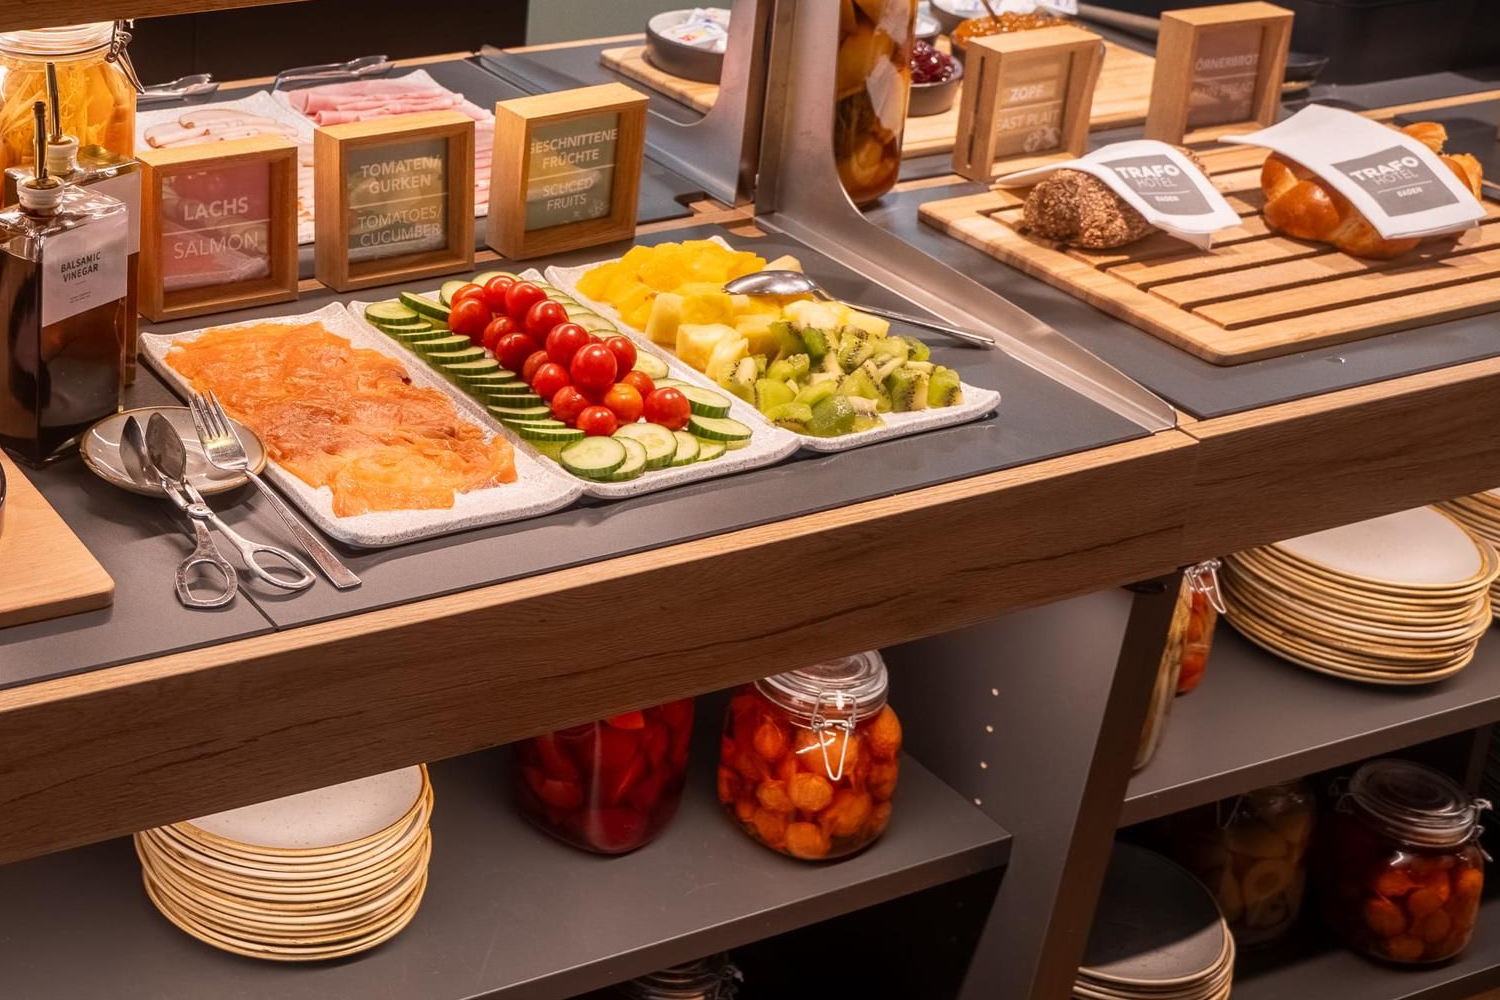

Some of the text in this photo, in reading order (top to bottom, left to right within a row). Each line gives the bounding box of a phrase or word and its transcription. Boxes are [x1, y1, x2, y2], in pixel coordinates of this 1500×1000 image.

[542, 149, 600, 169] FRÜCHTE
[1349, 156, 1420, 181] TRAFO
[1115, 164, 1180, 179] TRAFO
[1372, 168, 1420, 186] HOTEL
[369, 174, 432, 194] GURKEN
[1134, 177, 1178, 189] HOTEL
[184, 196, 249, 221] LACHS
[547, 193, 587, 211] FRUITS
[173, 231, 259, 259] SALMON
[61, 252, 101, 273] BALSAMIC
[63, 263, 99, 283] VINEGAR
